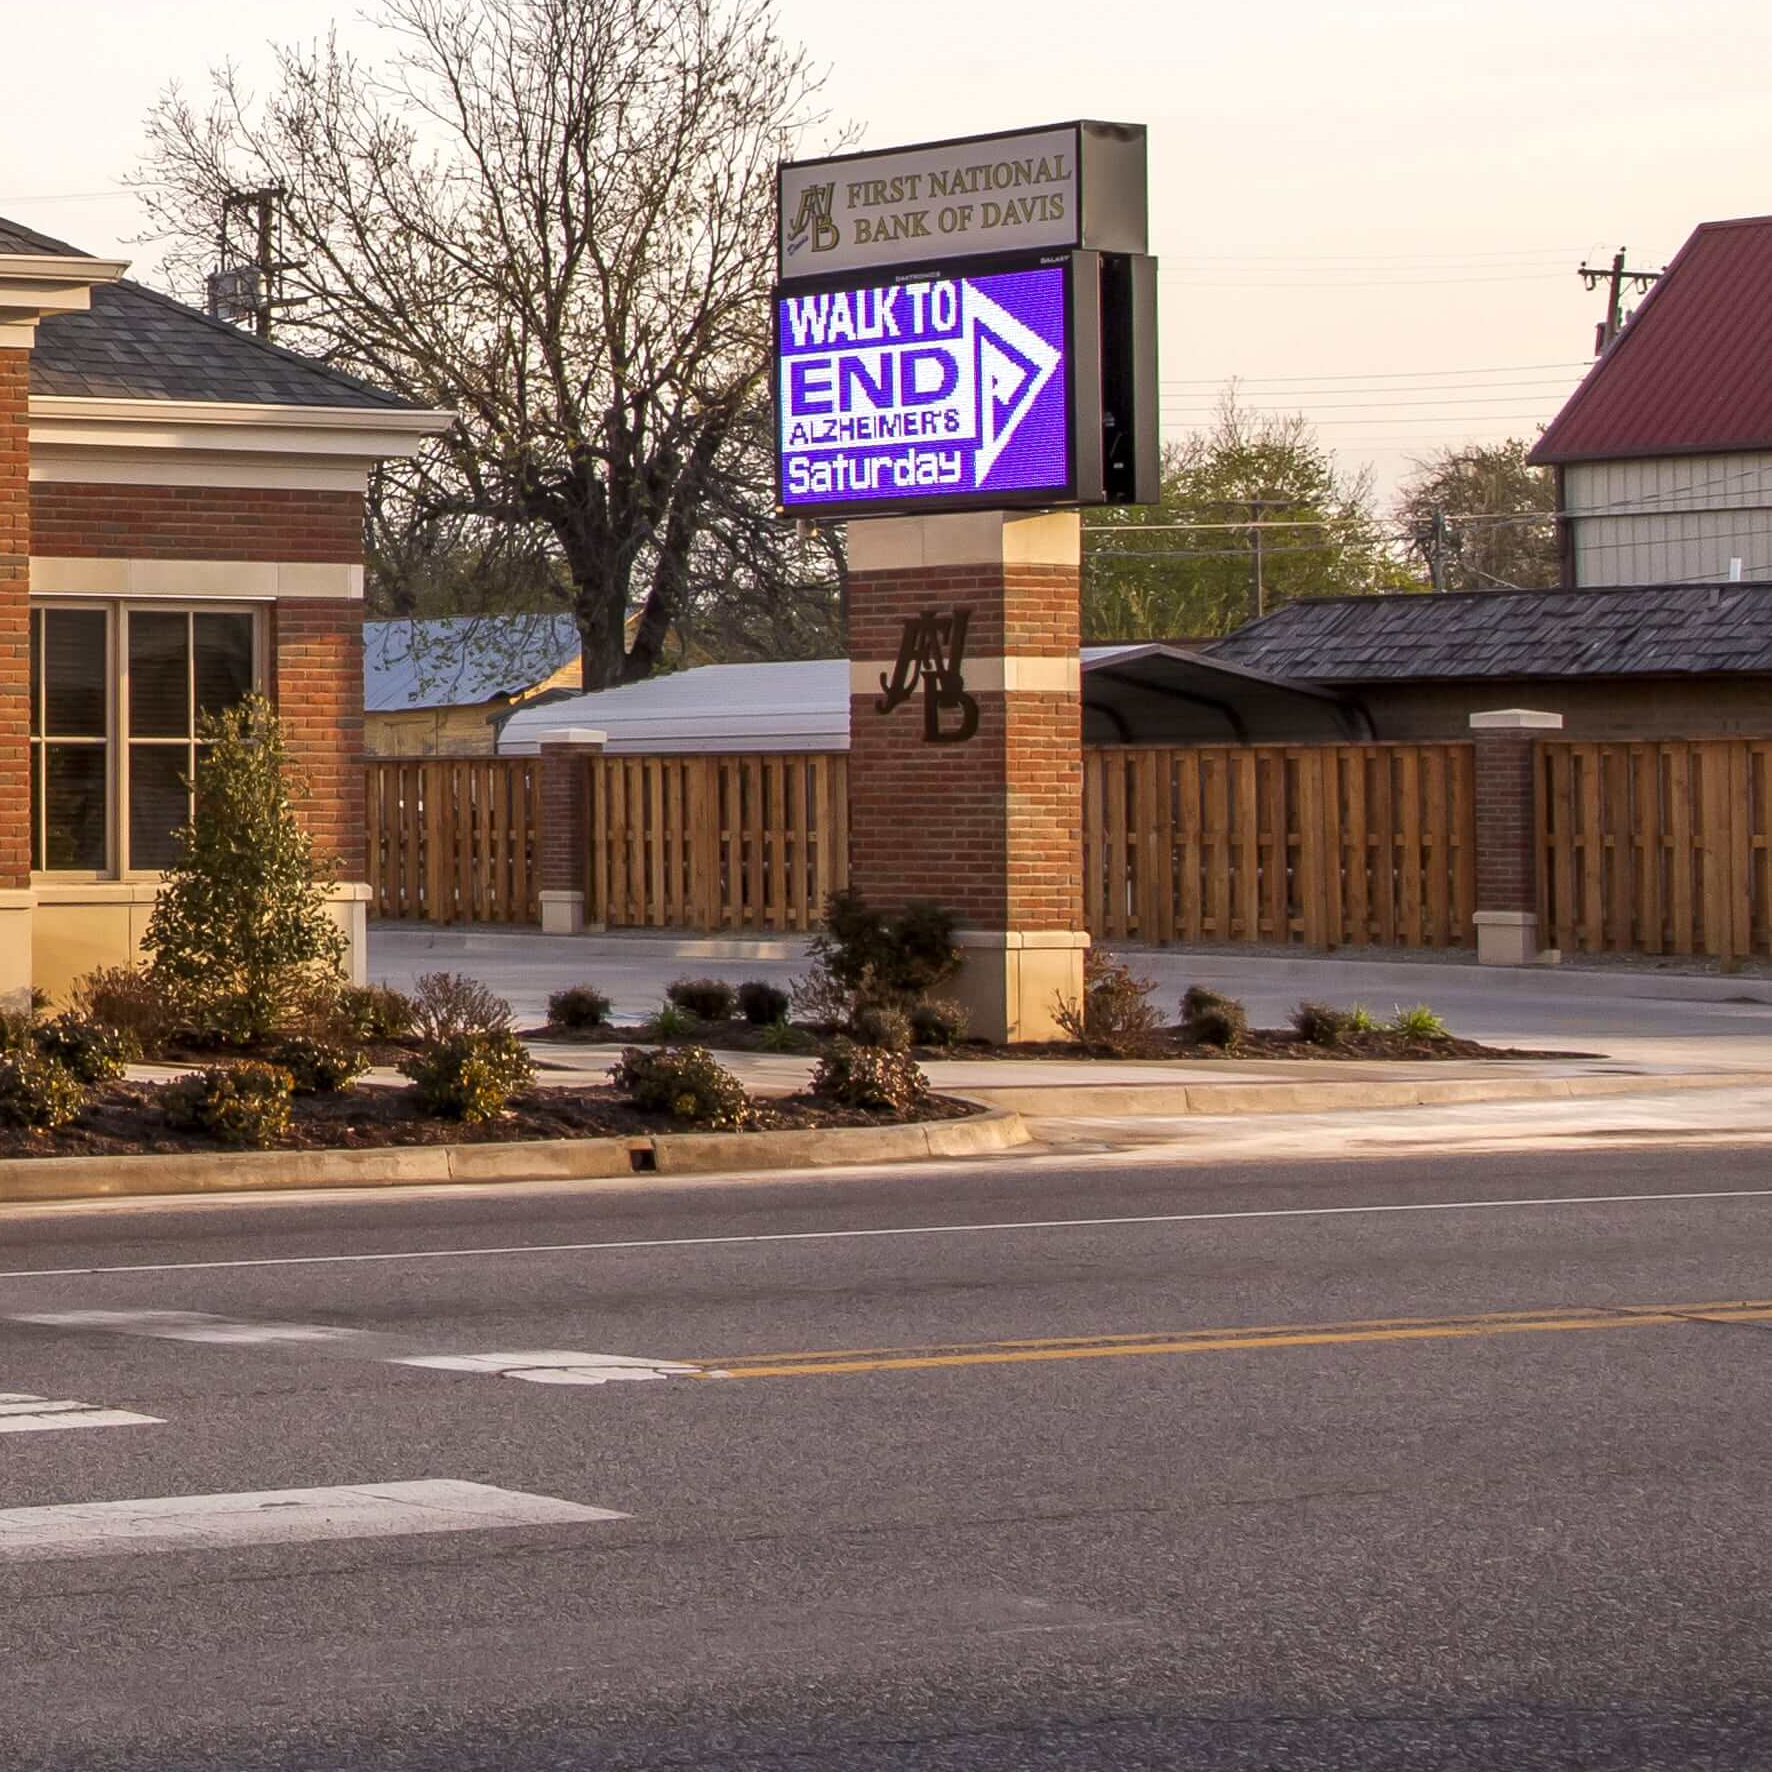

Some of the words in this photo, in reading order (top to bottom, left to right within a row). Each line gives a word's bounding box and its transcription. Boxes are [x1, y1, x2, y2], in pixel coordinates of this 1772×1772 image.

[846, 174, 922, 209] FIRST
[927, 154, 1072, 199] NATIONAL
[854, 210, 932, 245] BANK
[938, 204, 975, 234] OF
[981, 193, 1065, 229] DAVIS
[786, 285, 902, 347] WALK
[906, 279, 957, 335] TO
[791, 347, 959, 417] END
[789, 409, 960, 446] ALZHEIMER'S
[788, 448, 962, 494] Saturday
